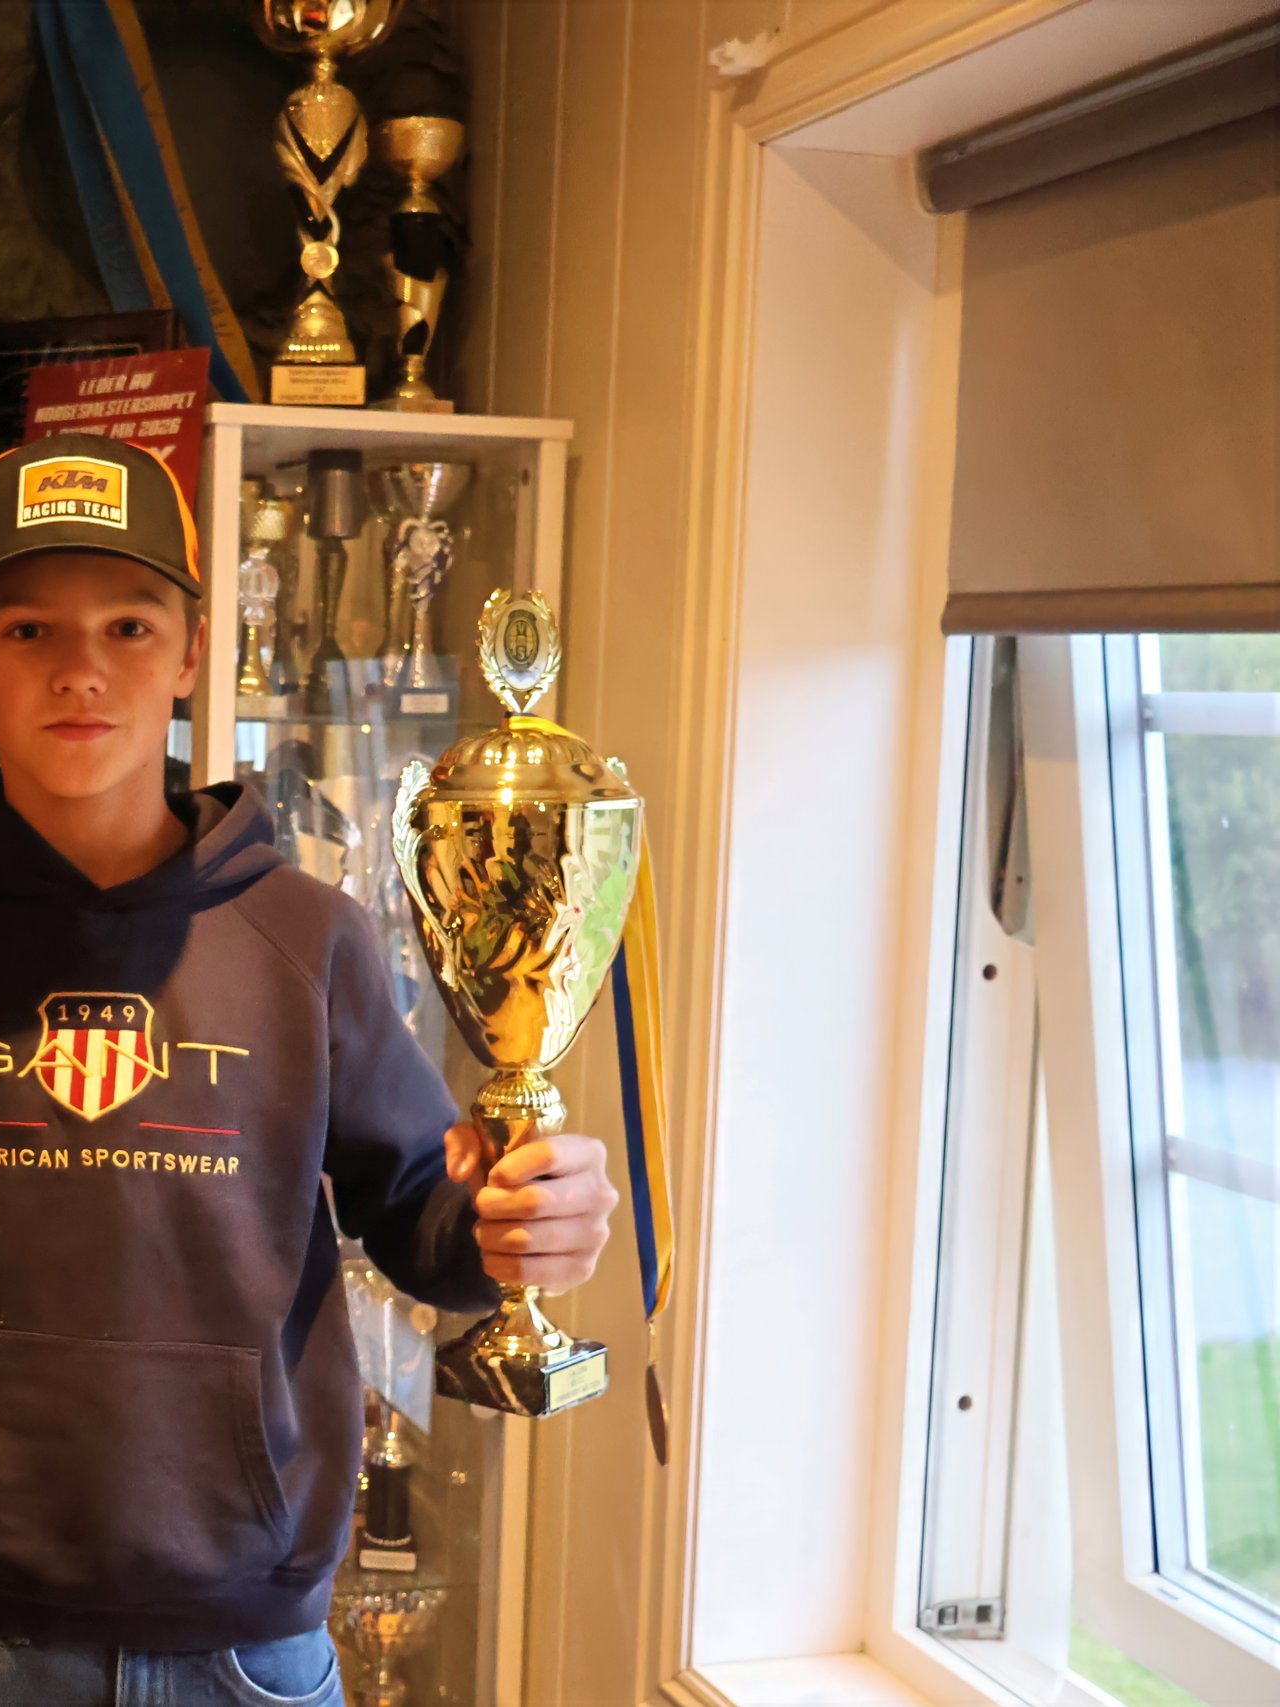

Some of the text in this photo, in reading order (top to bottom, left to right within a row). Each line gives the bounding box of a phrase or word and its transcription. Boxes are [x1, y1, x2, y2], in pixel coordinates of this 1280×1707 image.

[79, 374, 127, 396] LEDER
[137, 417, 183, 437] 2026
[38, 470, 108, 493] KTM
[24, 500, 121, 522] RACING TEAM
[56, 1004, 136, 1023] 1949
[81, 1148, 239, 1175] SPORTSWEAR
